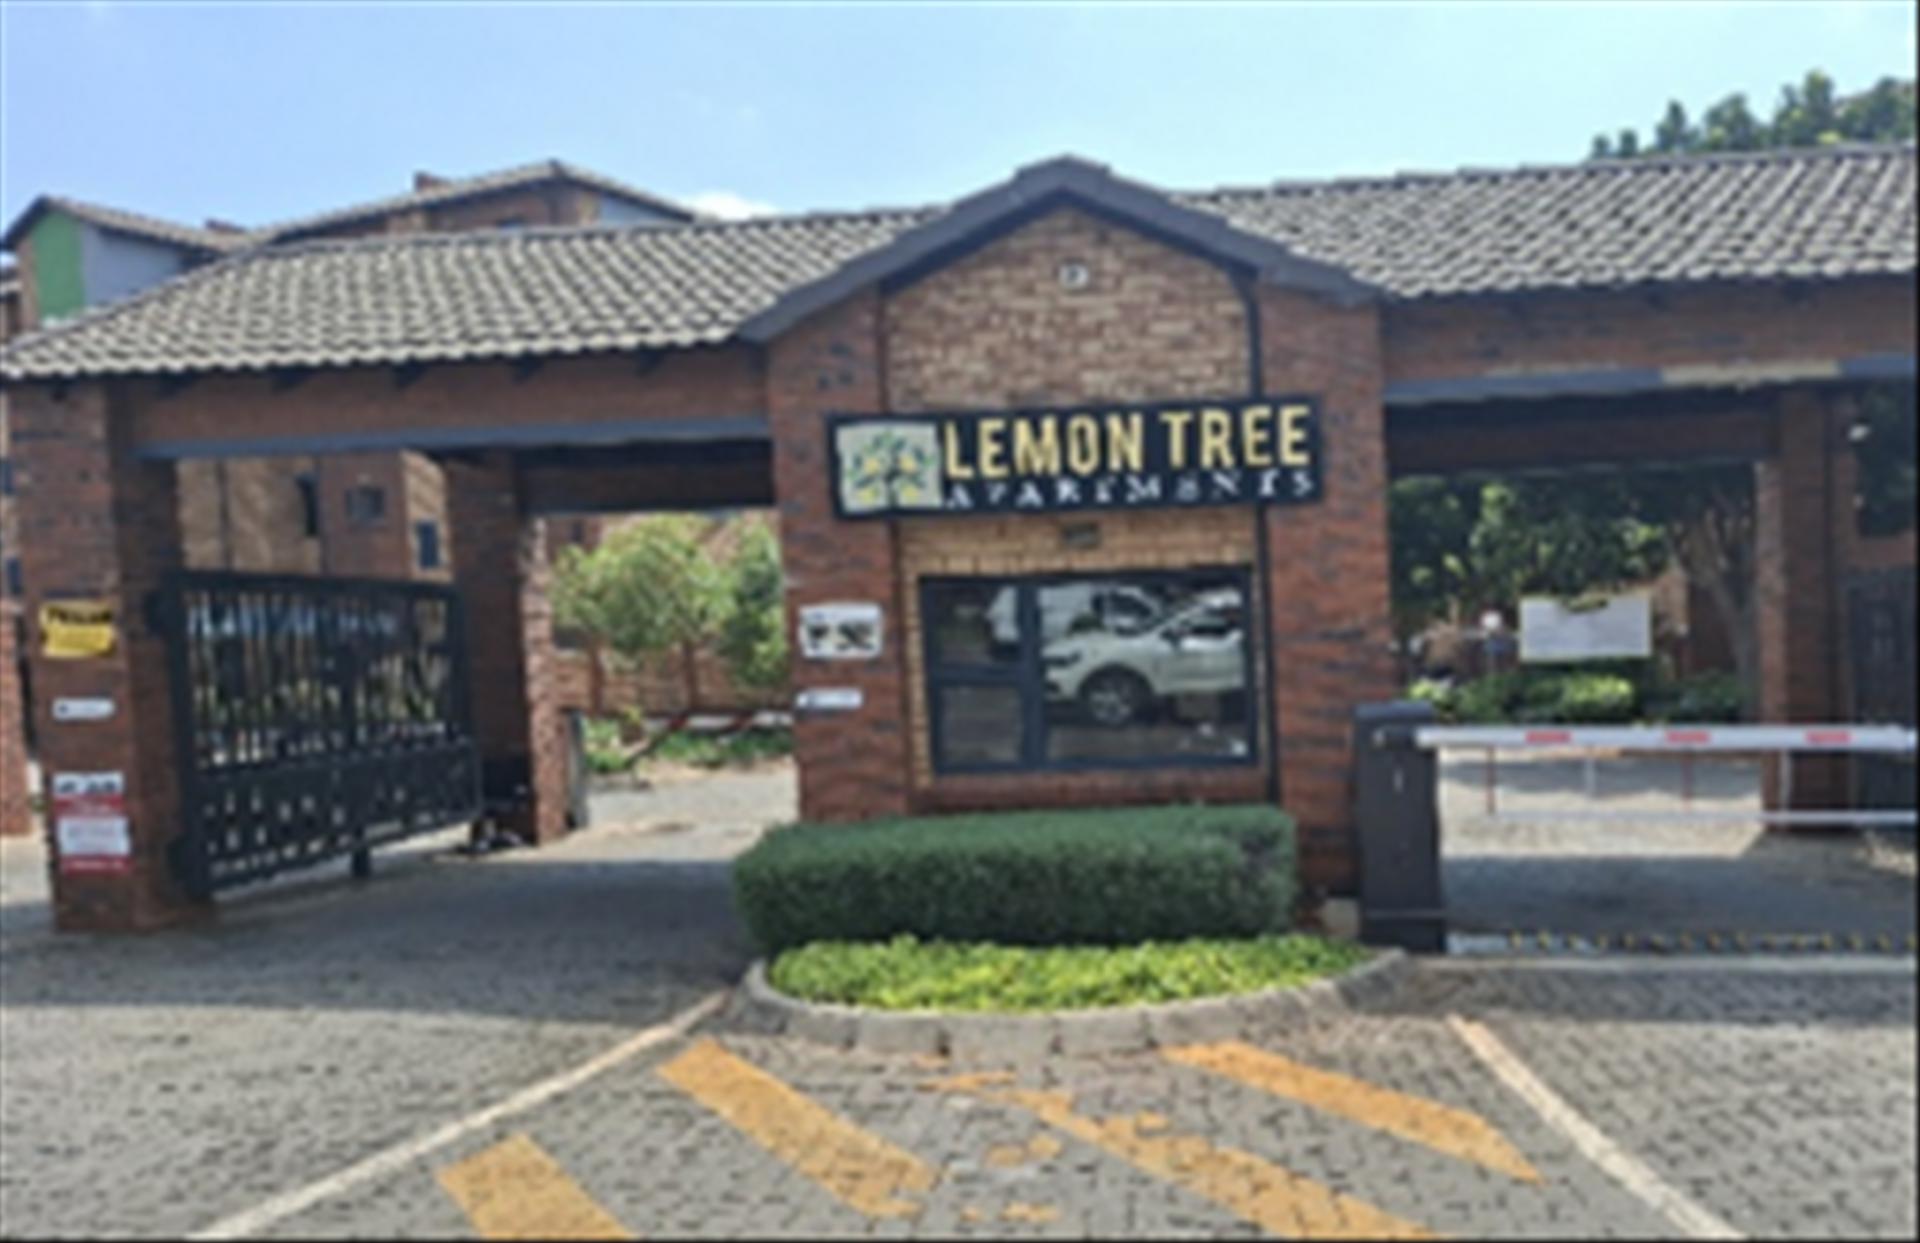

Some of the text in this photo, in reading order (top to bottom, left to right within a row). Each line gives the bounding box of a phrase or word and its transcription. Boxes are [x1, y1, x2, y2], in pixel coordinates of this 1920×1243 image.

[944, 405, 1311, 480] LEMON TREE
[944, 468, 1314, 509] APARTMENTS
